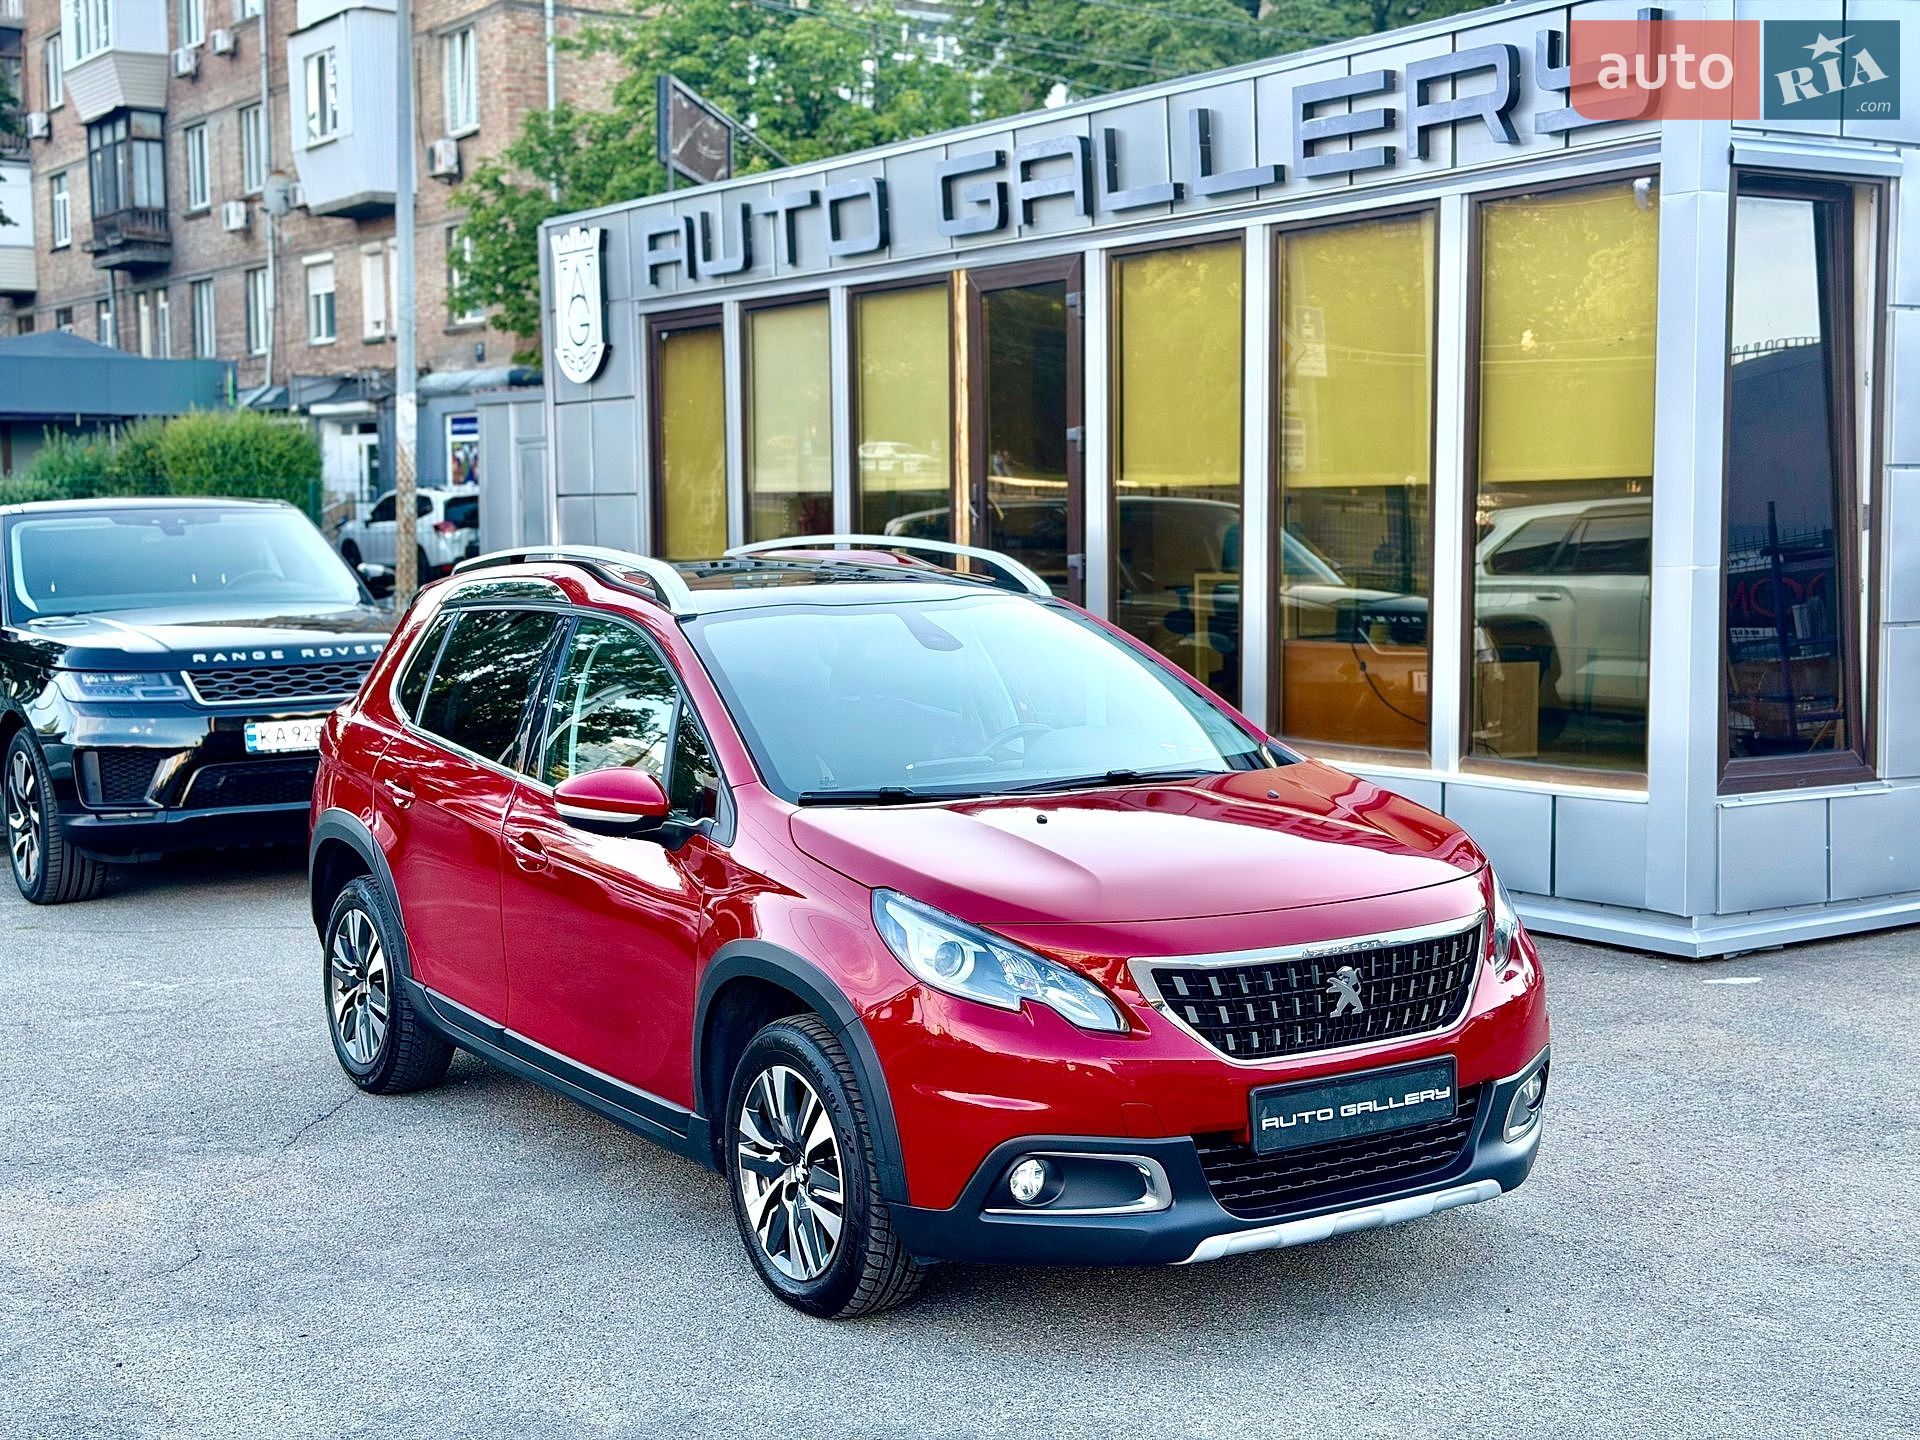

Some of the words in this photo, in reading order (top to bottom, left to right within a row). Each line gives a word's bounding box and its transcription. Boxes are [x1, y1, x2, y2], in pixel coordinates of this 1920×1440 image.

[643, 176, 890, 287] AUTO
[935, 7, 1663, 237] GALLERY
[192, 649, 285, 664] RANGE
[300, 643, 384, 659] ROVER
[1310, 939, 1379, 958] PEUGEOT
[1261, 1107, 1334, 1131] AUTO
[1339, 1086, 1451, 1118] GALLERY
